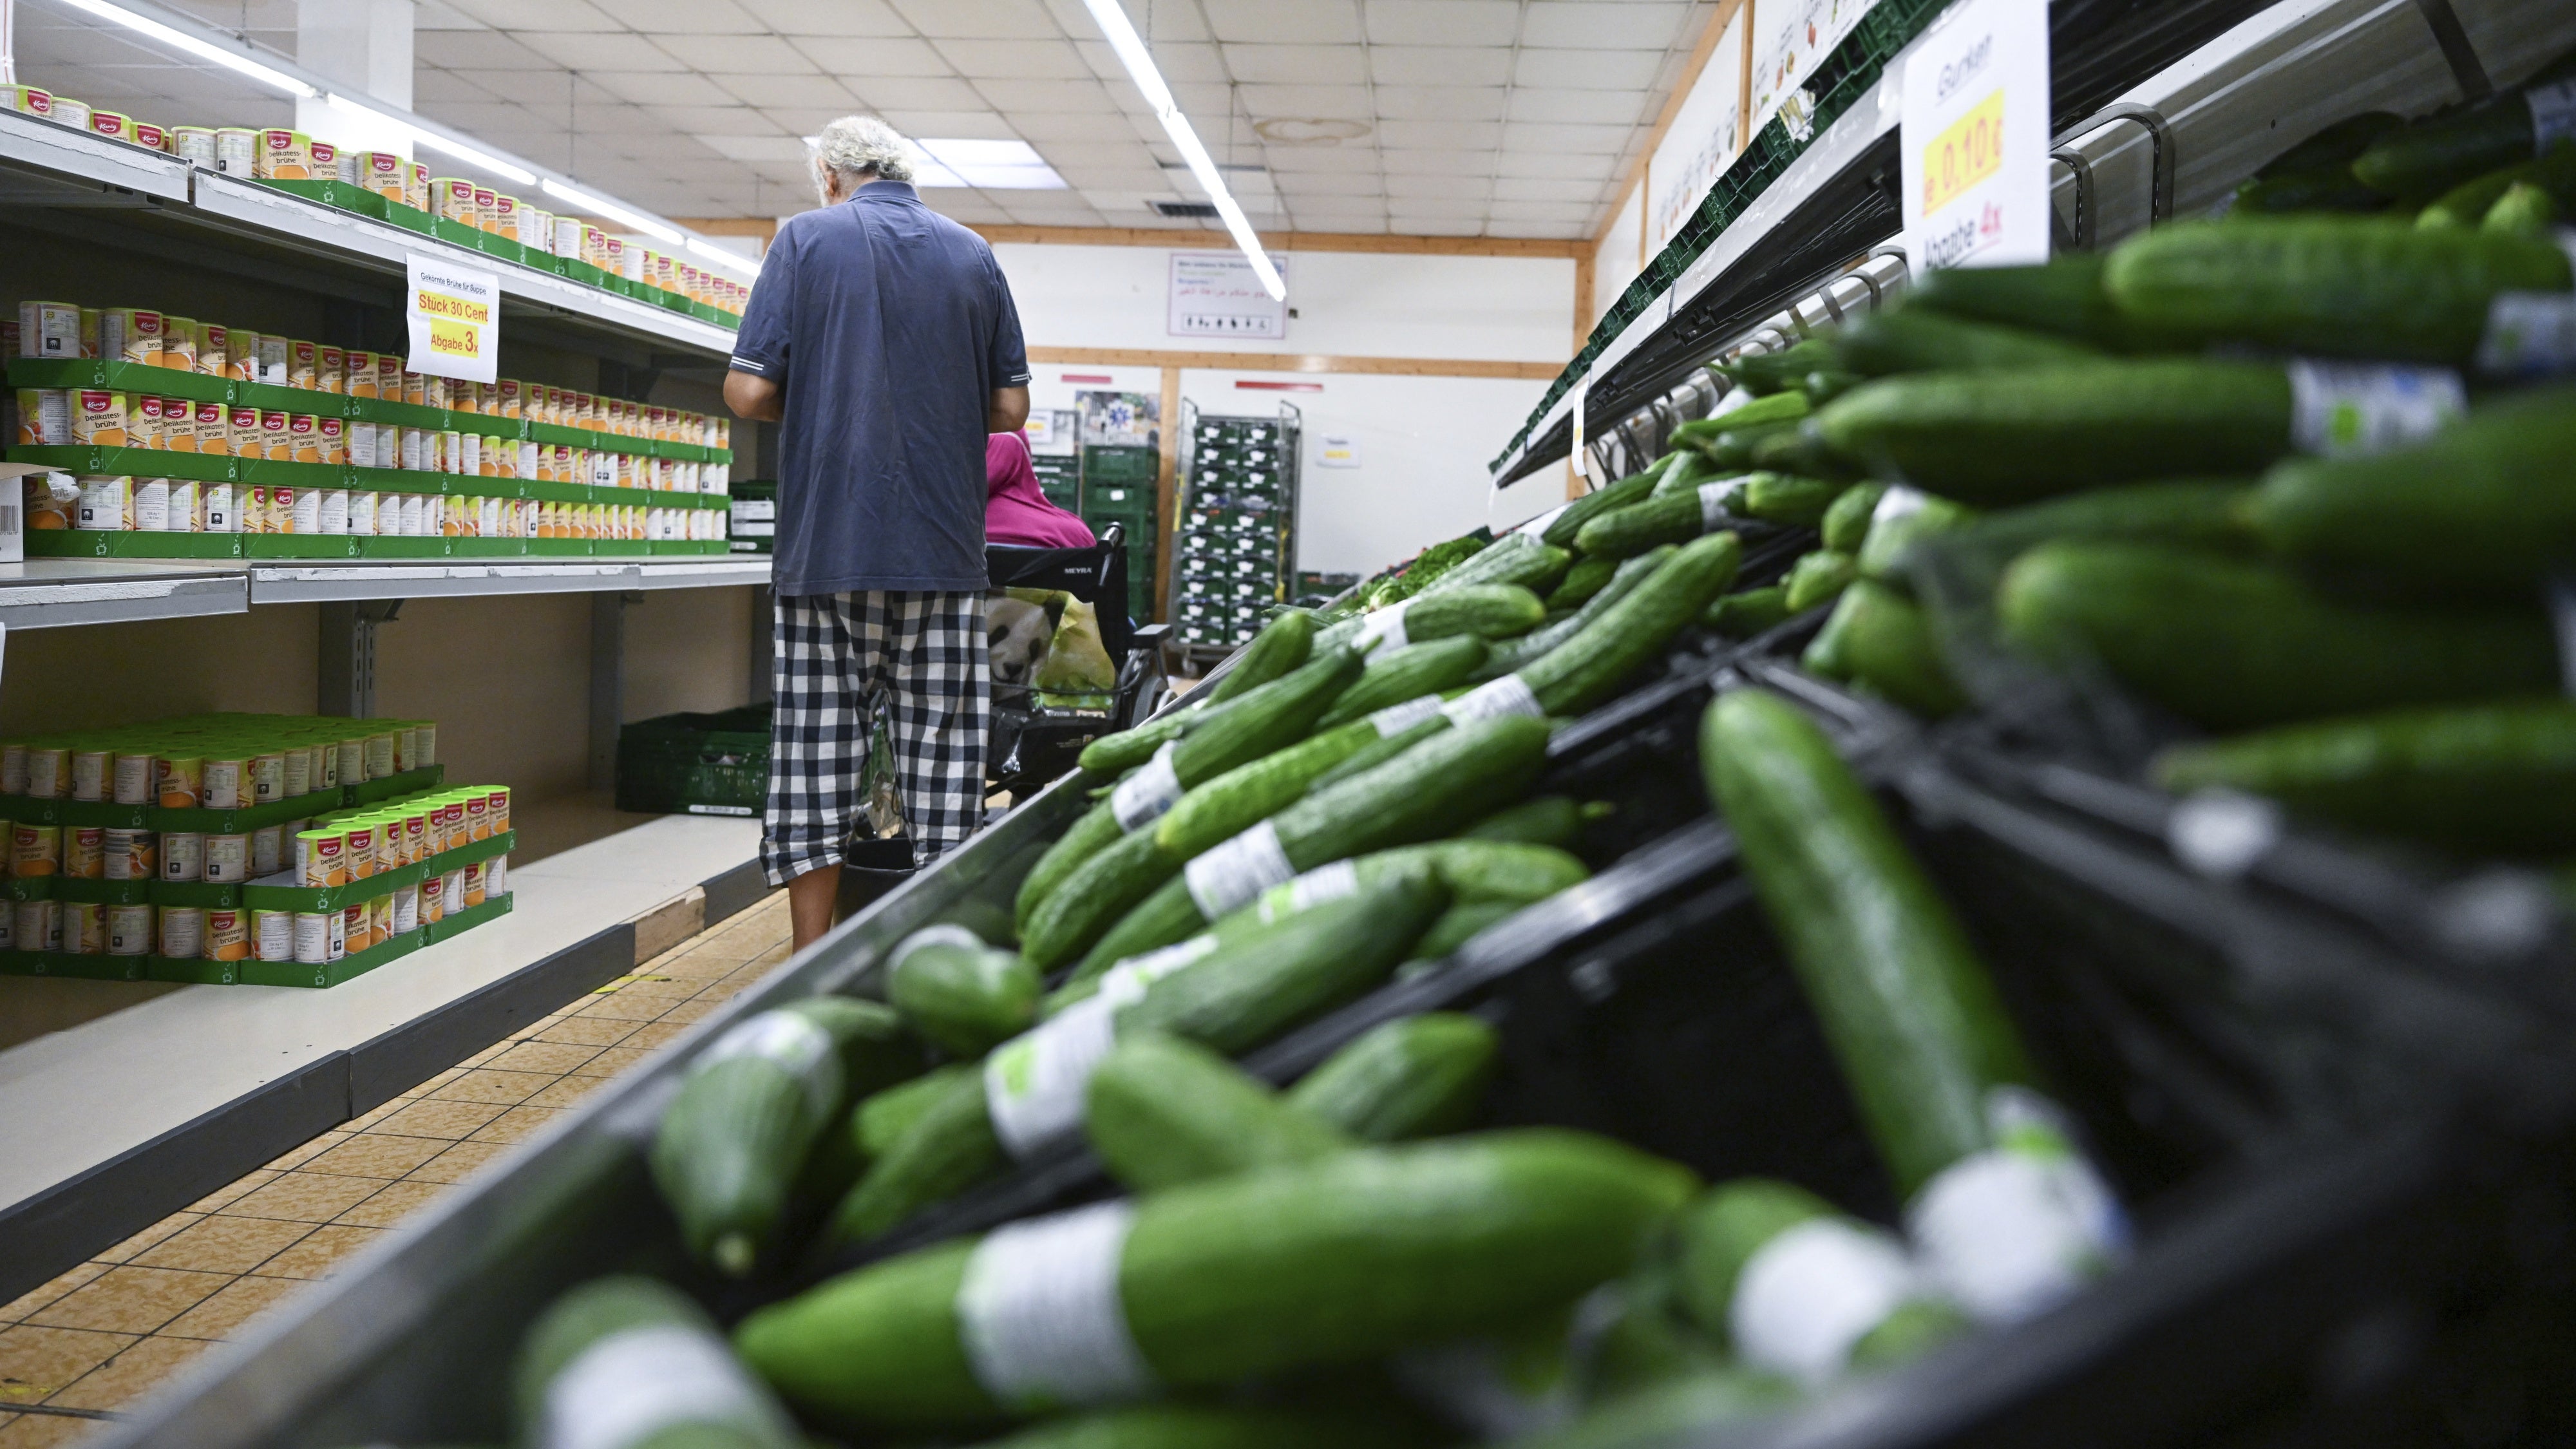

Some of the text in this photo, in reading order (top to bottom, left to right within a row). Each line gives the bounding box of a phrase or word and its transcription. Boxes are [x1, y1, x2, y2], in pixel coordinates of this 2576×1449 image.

[421, 272, 446, 285] Gekörnte
[446, 278, 462, 289] Brühe
[469, 285, 487, 295] Suppe
[419, 294, 489, 322] Stück 30 Cent
[431, 334, 462, 351] Abgabe
[85, 413, 121, 422] Delikatess-
[212, 927, 245, 940] Delikatess-
[347, 925, 365, 936] brühe
[220, 934, 240, 945] brühe
